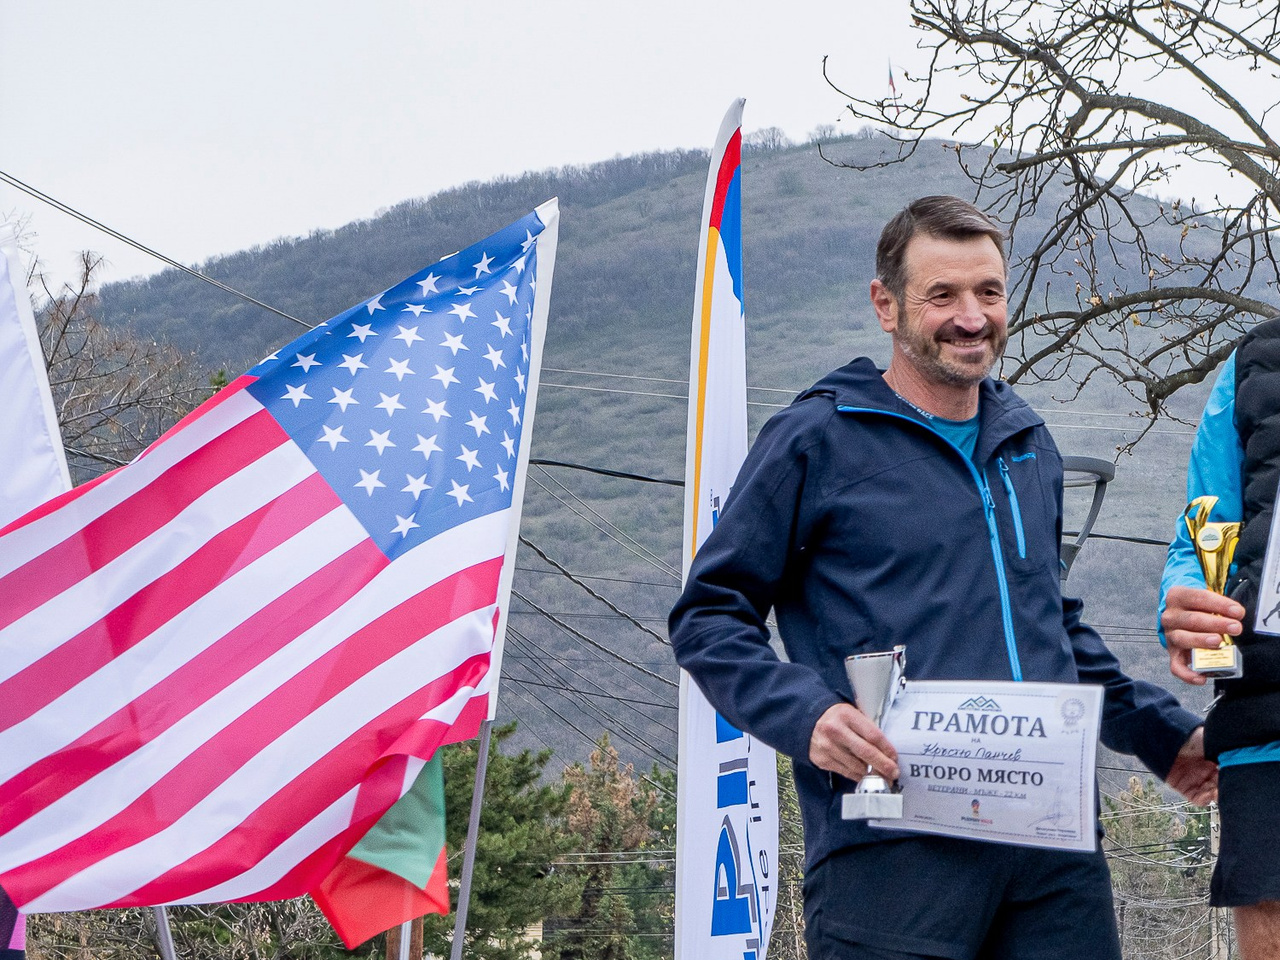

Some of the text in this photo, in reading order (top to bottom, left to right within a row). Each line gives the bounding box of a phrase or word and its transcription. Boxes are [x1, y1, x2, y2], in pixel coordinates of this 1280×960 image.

[911, 711, 1047, 738] ГРАМОТА
[910, 763, 1044, 786] ВТОРО МЯСТО
